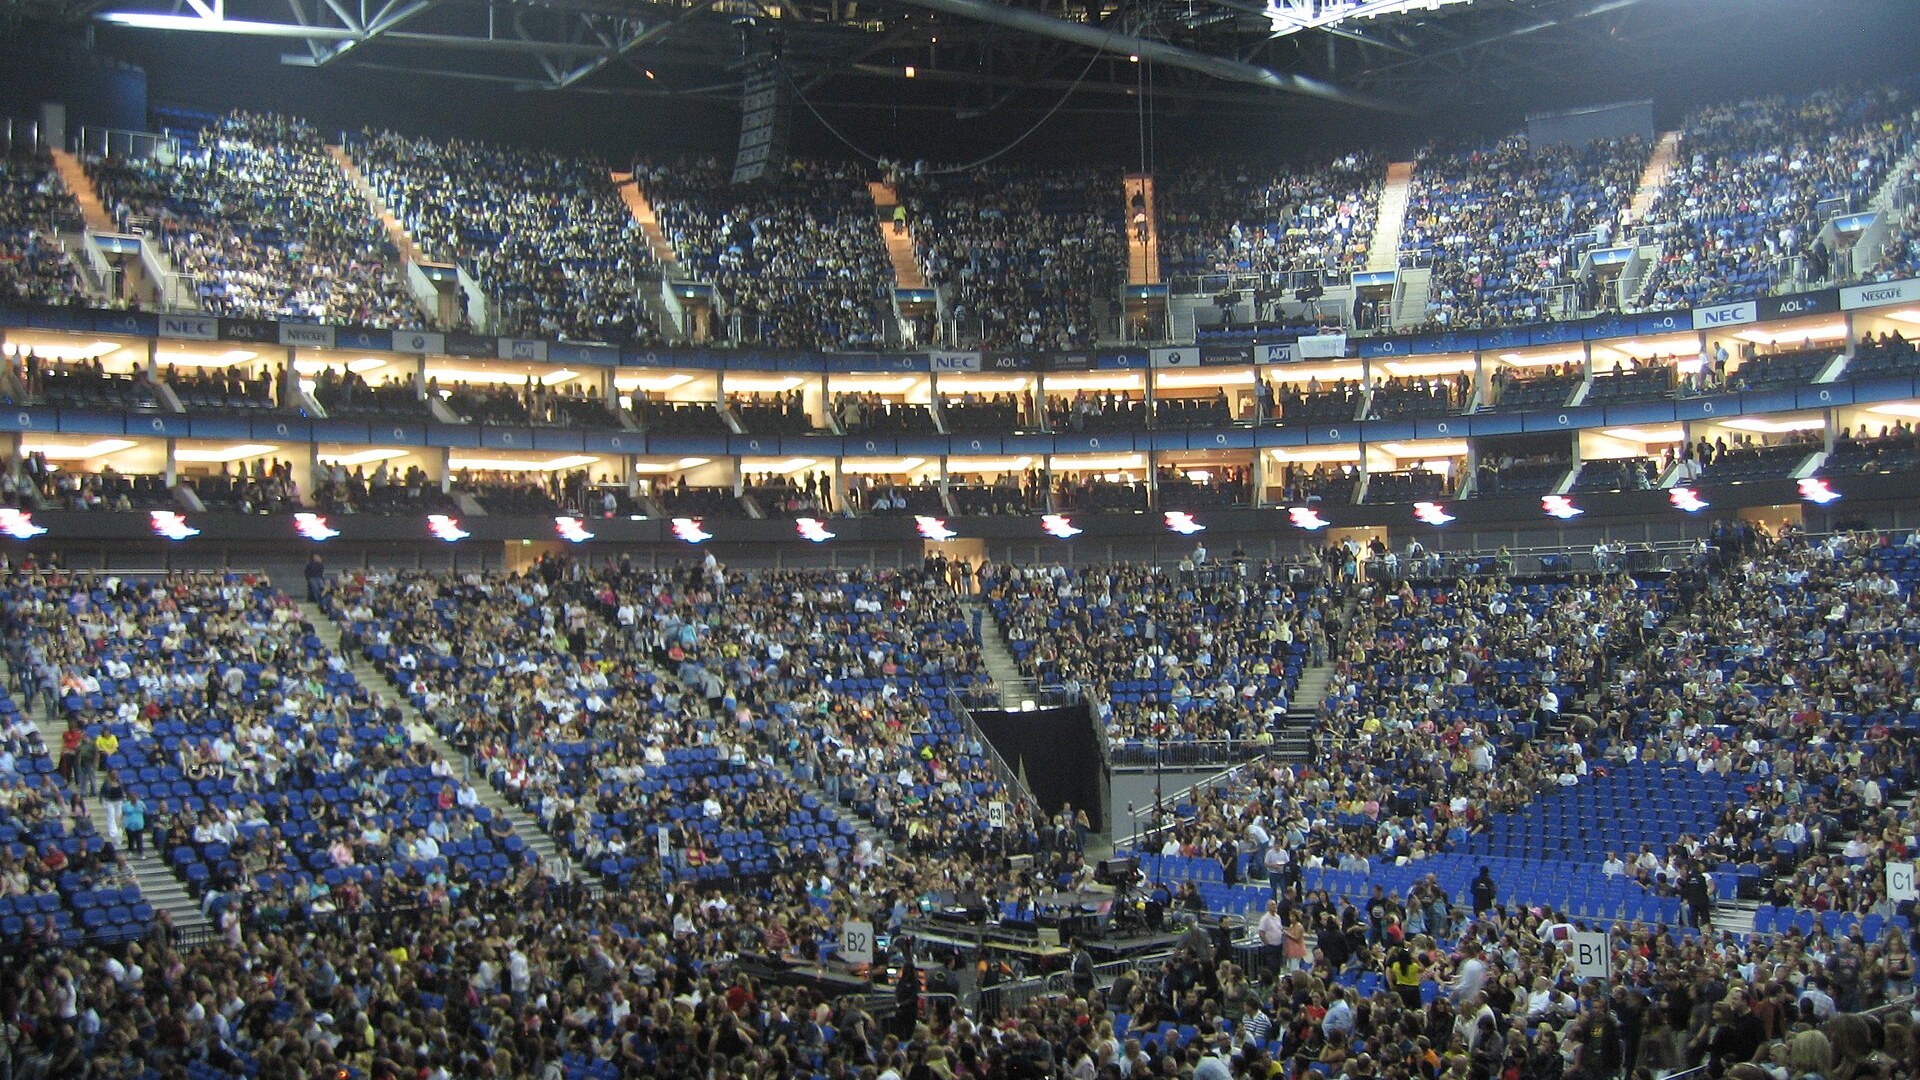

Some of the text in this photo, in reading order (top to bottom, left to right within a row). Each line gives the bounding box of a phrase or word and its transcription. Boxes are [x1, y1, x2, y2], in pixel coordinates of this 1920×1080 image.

[1779, 301, 1802, 313] AOL
[1705, 308, 1744, 323] NEC
[1269, 348, 1289, 361] ADT
[936, 358, 974, 368] NEC
[996, 358, 1016, 367] AOL
[991, 808, 1001, 820] C3
[1893, 872, 1911, 891] C1
[847, 932, 866, 952] B2
[1579, 943, 1602, 965] B1
